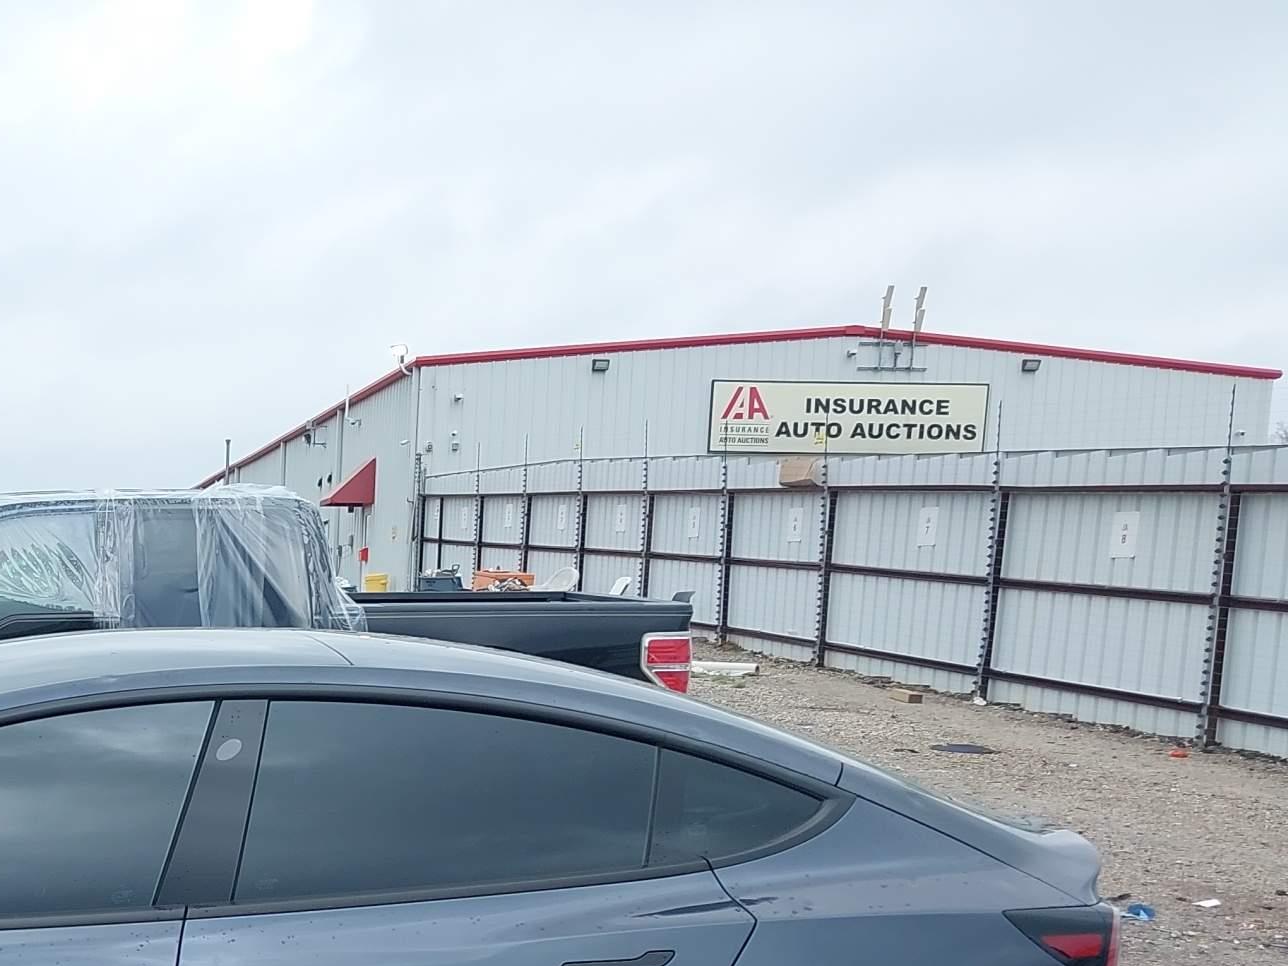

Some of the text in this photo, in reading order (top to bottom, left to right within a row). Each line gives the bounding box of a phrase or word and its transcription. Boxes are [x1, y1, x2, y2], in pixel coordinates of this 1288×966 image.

[805, 397, 950, 415] INSURANCE
[775, 421, 843, 438] AUTO
[850, 422, 977, 440] AUCTIONS
